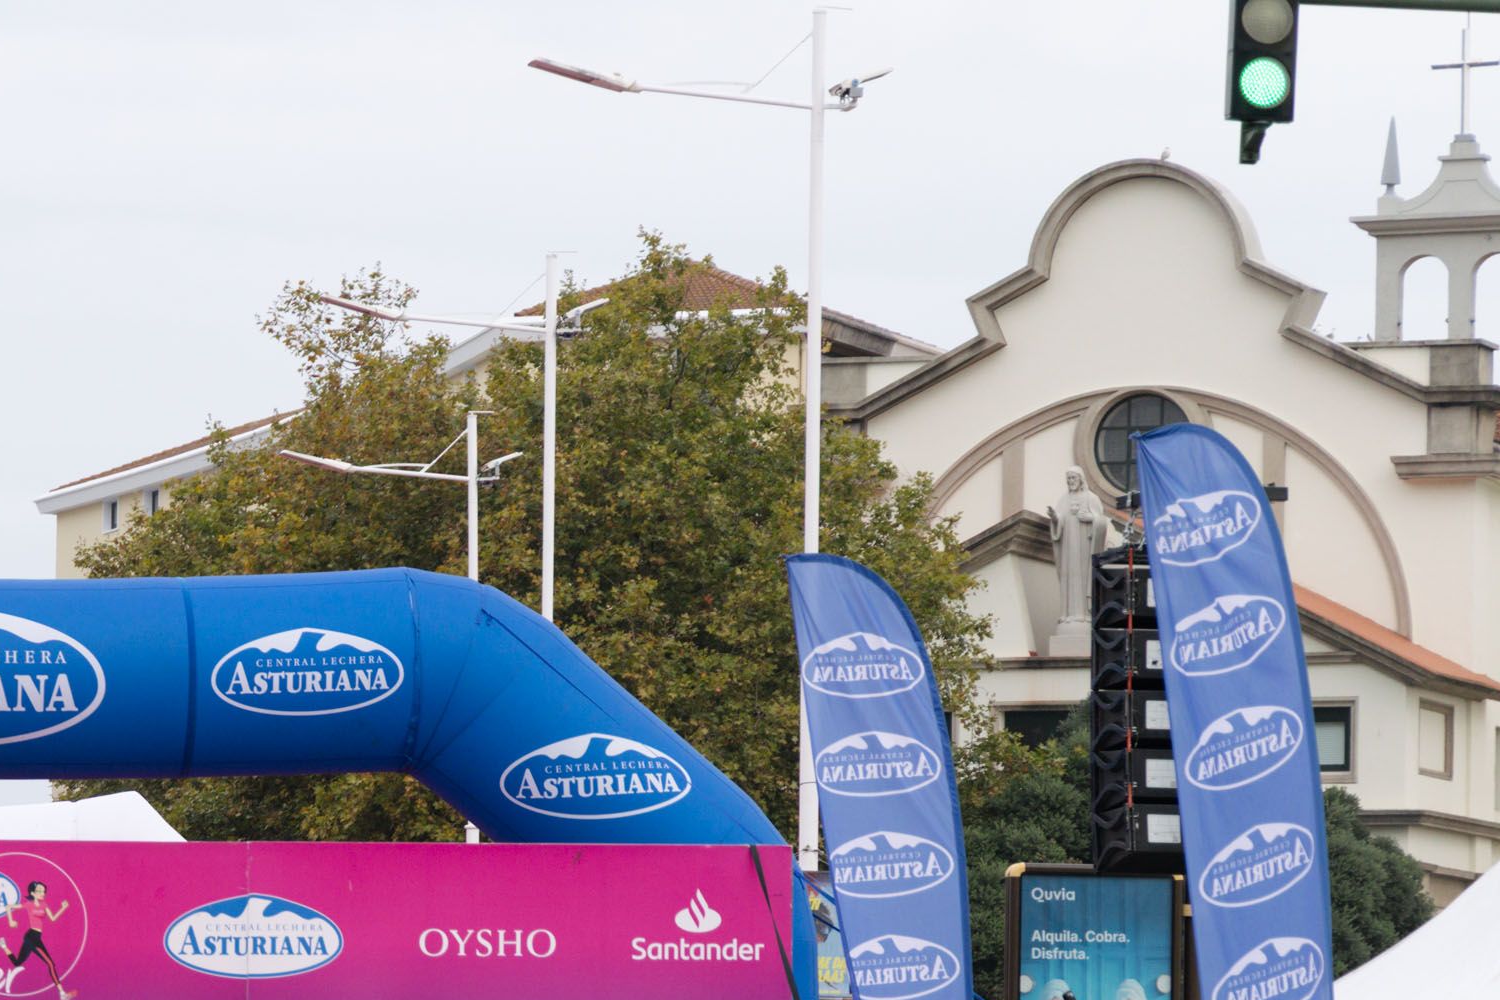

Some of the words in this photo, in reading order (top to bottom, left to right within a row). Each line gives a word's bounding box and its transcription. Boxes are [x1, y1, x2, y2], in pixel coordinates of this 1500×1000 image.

[256, 658, 316, 668] CENTRAL
[322, 655, 383, 665] LECHERA
[225, 661, 390, 695] ASTURIANA
[545, 761, 607, 774] CENTRAL
[612, 760, 670, 771] LECHERA
[515, 768, 682, 799] ASTURIANA
[1031, 887, 1076, 902] Quvia
[206, 923, 261, 931] CENTRAL
[267, 924, 324, 932] LECHERA
[178, 924, 330, 956] ASTURIANA
[419, 928, 557, 958] OYSHO
[1031, 930, 1083, 945] Alquila.
[1085, 930, 1131, 943] Cobra.
[631, 937, 765, 961] Santander
[1031, 948, 1090, 960] Disfruta.
